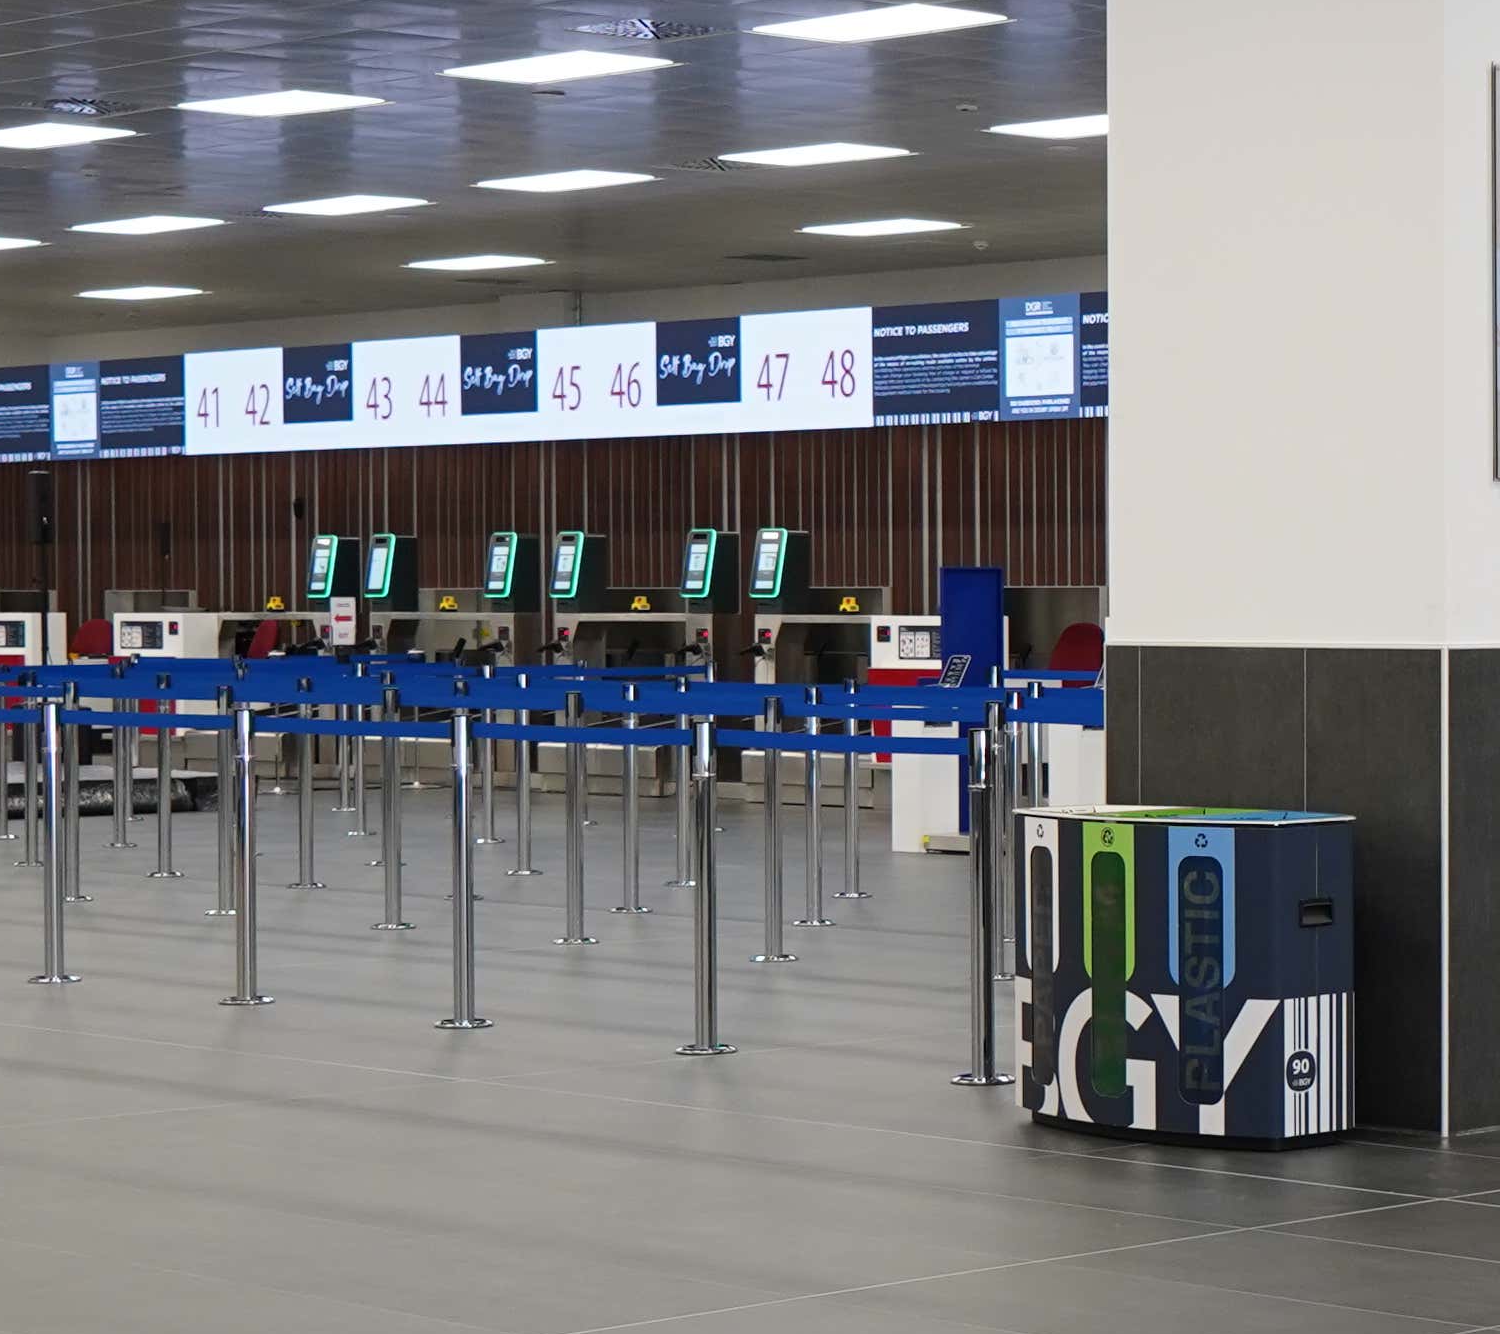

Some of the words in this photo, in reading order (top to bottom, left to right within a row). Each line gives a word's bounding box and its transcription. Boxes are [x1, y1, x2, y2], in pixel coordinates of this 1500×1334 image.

[873, 326, 903, 338] NOTICE
[905, 325, 917, 336] TO
[917, 322, 970, 335] PASSENGERS
[1083, 313, 1108, 324] NOTIC
[717, 335, 736, 347] BGY
[366, 376, 393, 420] 43
[419, 373, 448, 418] 44
[552, 365, 581, 411] 45
[610, 361, 642, 408] 46
[757, 353, 789, 401] 47
[821, 349, 855, 398] 48
[197, 387, 220, 428] 41
[245, 384, 270, 427] 42
[1182, 870, 1221, 1092] PLASTIC
[1292, 1058, 1310, 1075] 90
